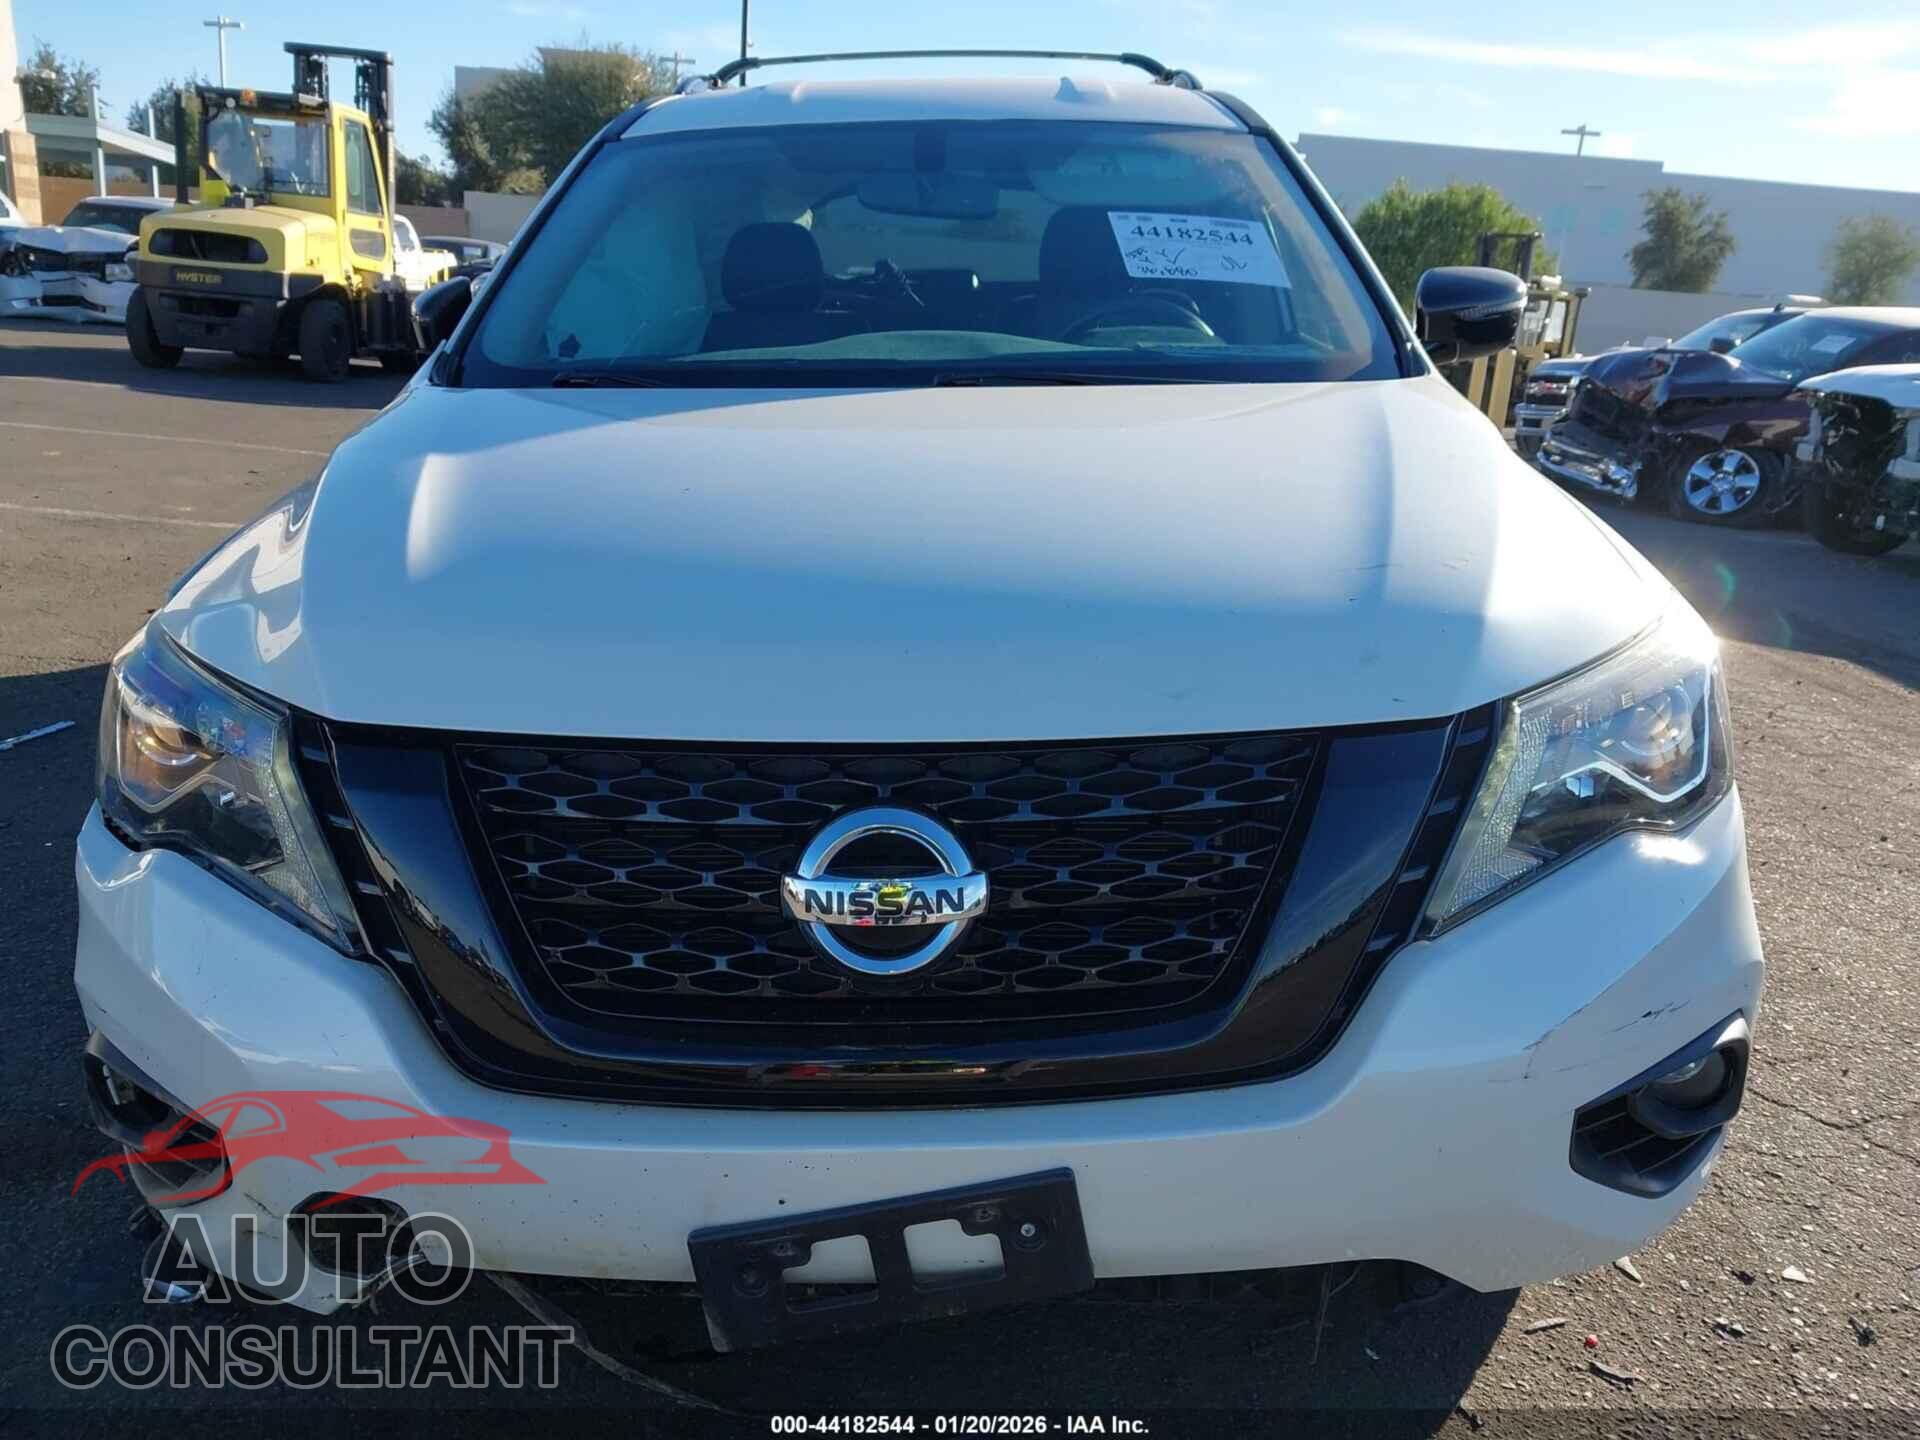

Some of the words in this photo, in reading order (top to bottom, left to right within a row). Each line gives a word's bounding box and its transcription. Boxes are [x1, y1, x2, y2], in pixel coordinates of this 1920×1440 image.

[1131, 225, 1253, 246] 44182544
[176, 271, 224, 284] HYSTER
[804, 887, 965, 917] NISSAN
